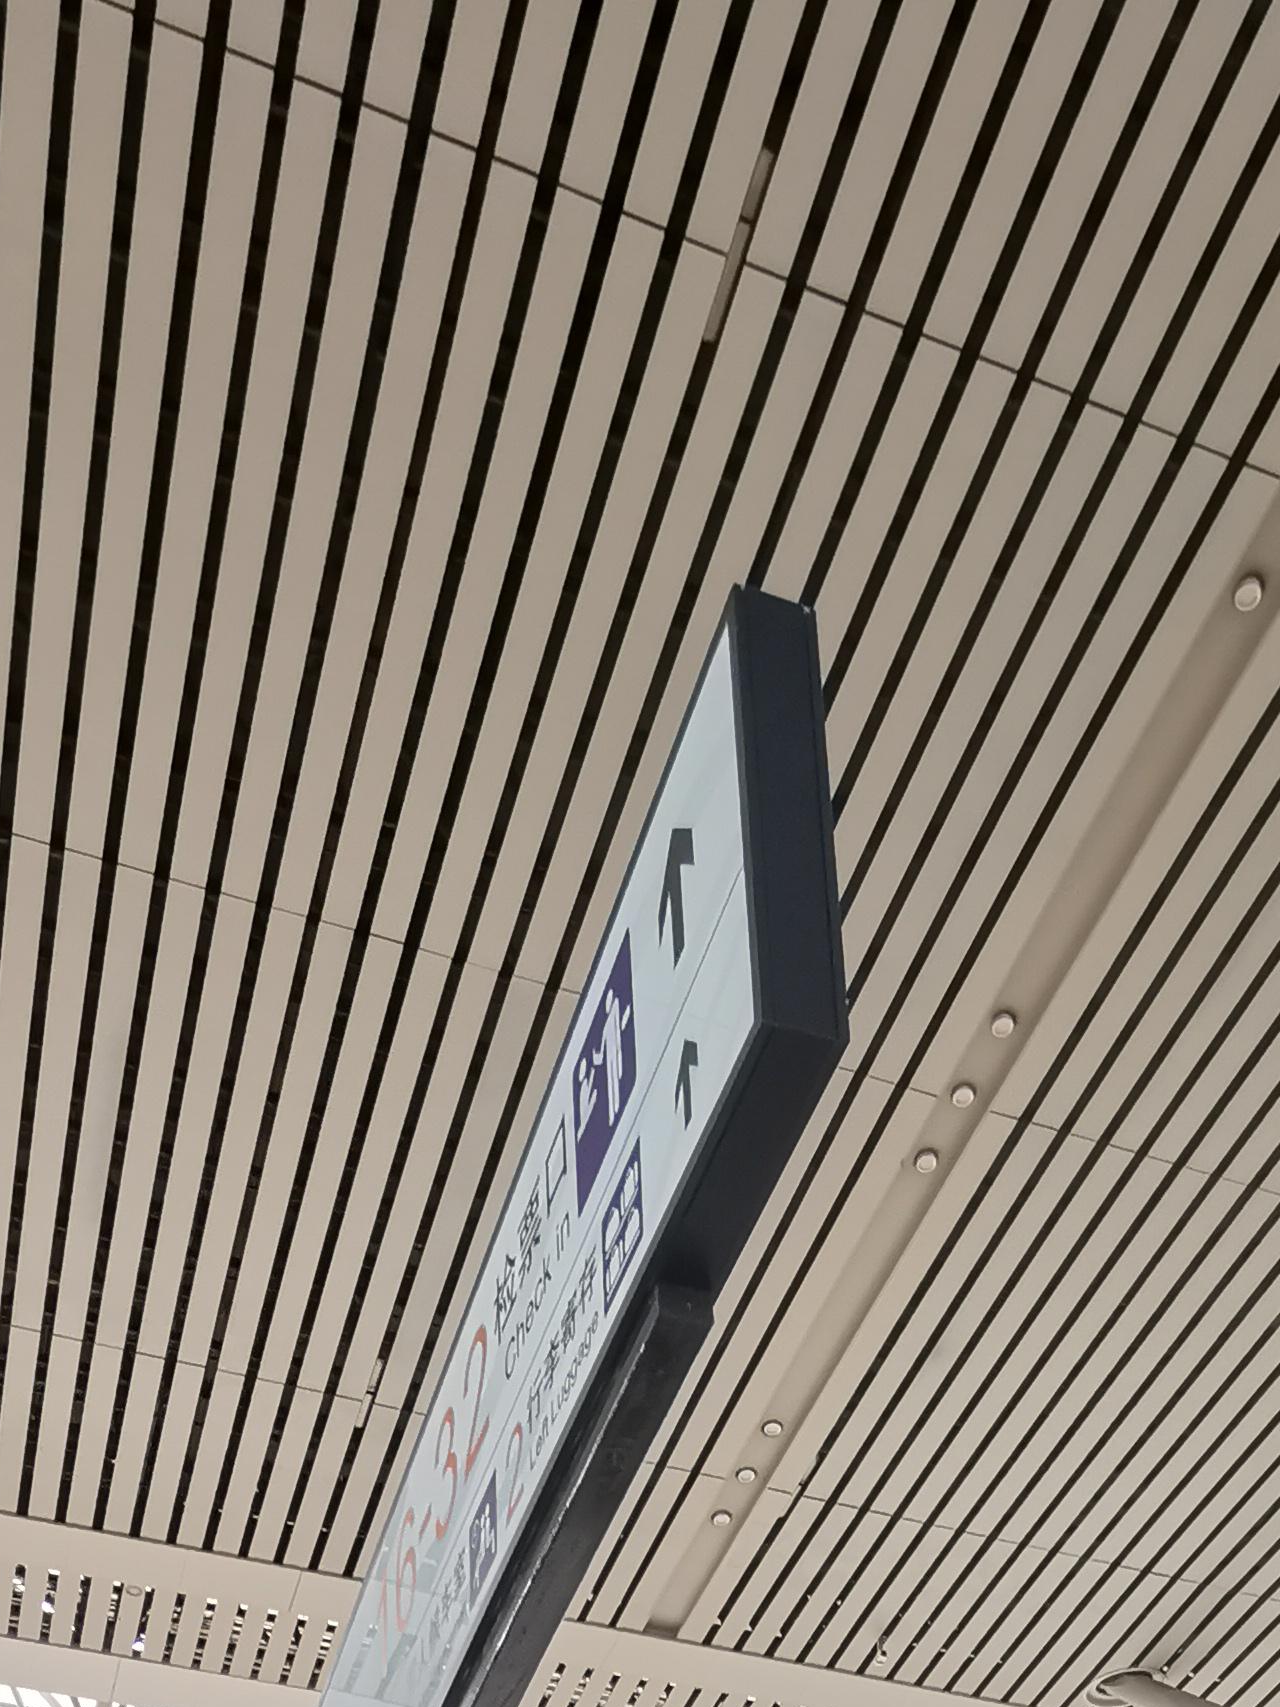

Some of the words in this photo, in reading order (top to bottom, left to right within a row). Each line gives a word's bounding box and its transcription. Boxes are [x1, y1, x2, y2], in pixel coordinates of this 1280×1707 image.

[494, 1112, 568, 1346] 检票口
[505, 1254, 552, 1380] Check
[556, 1211, 570, 1261] in
[377, 1324, 490, 1667] 16-32
